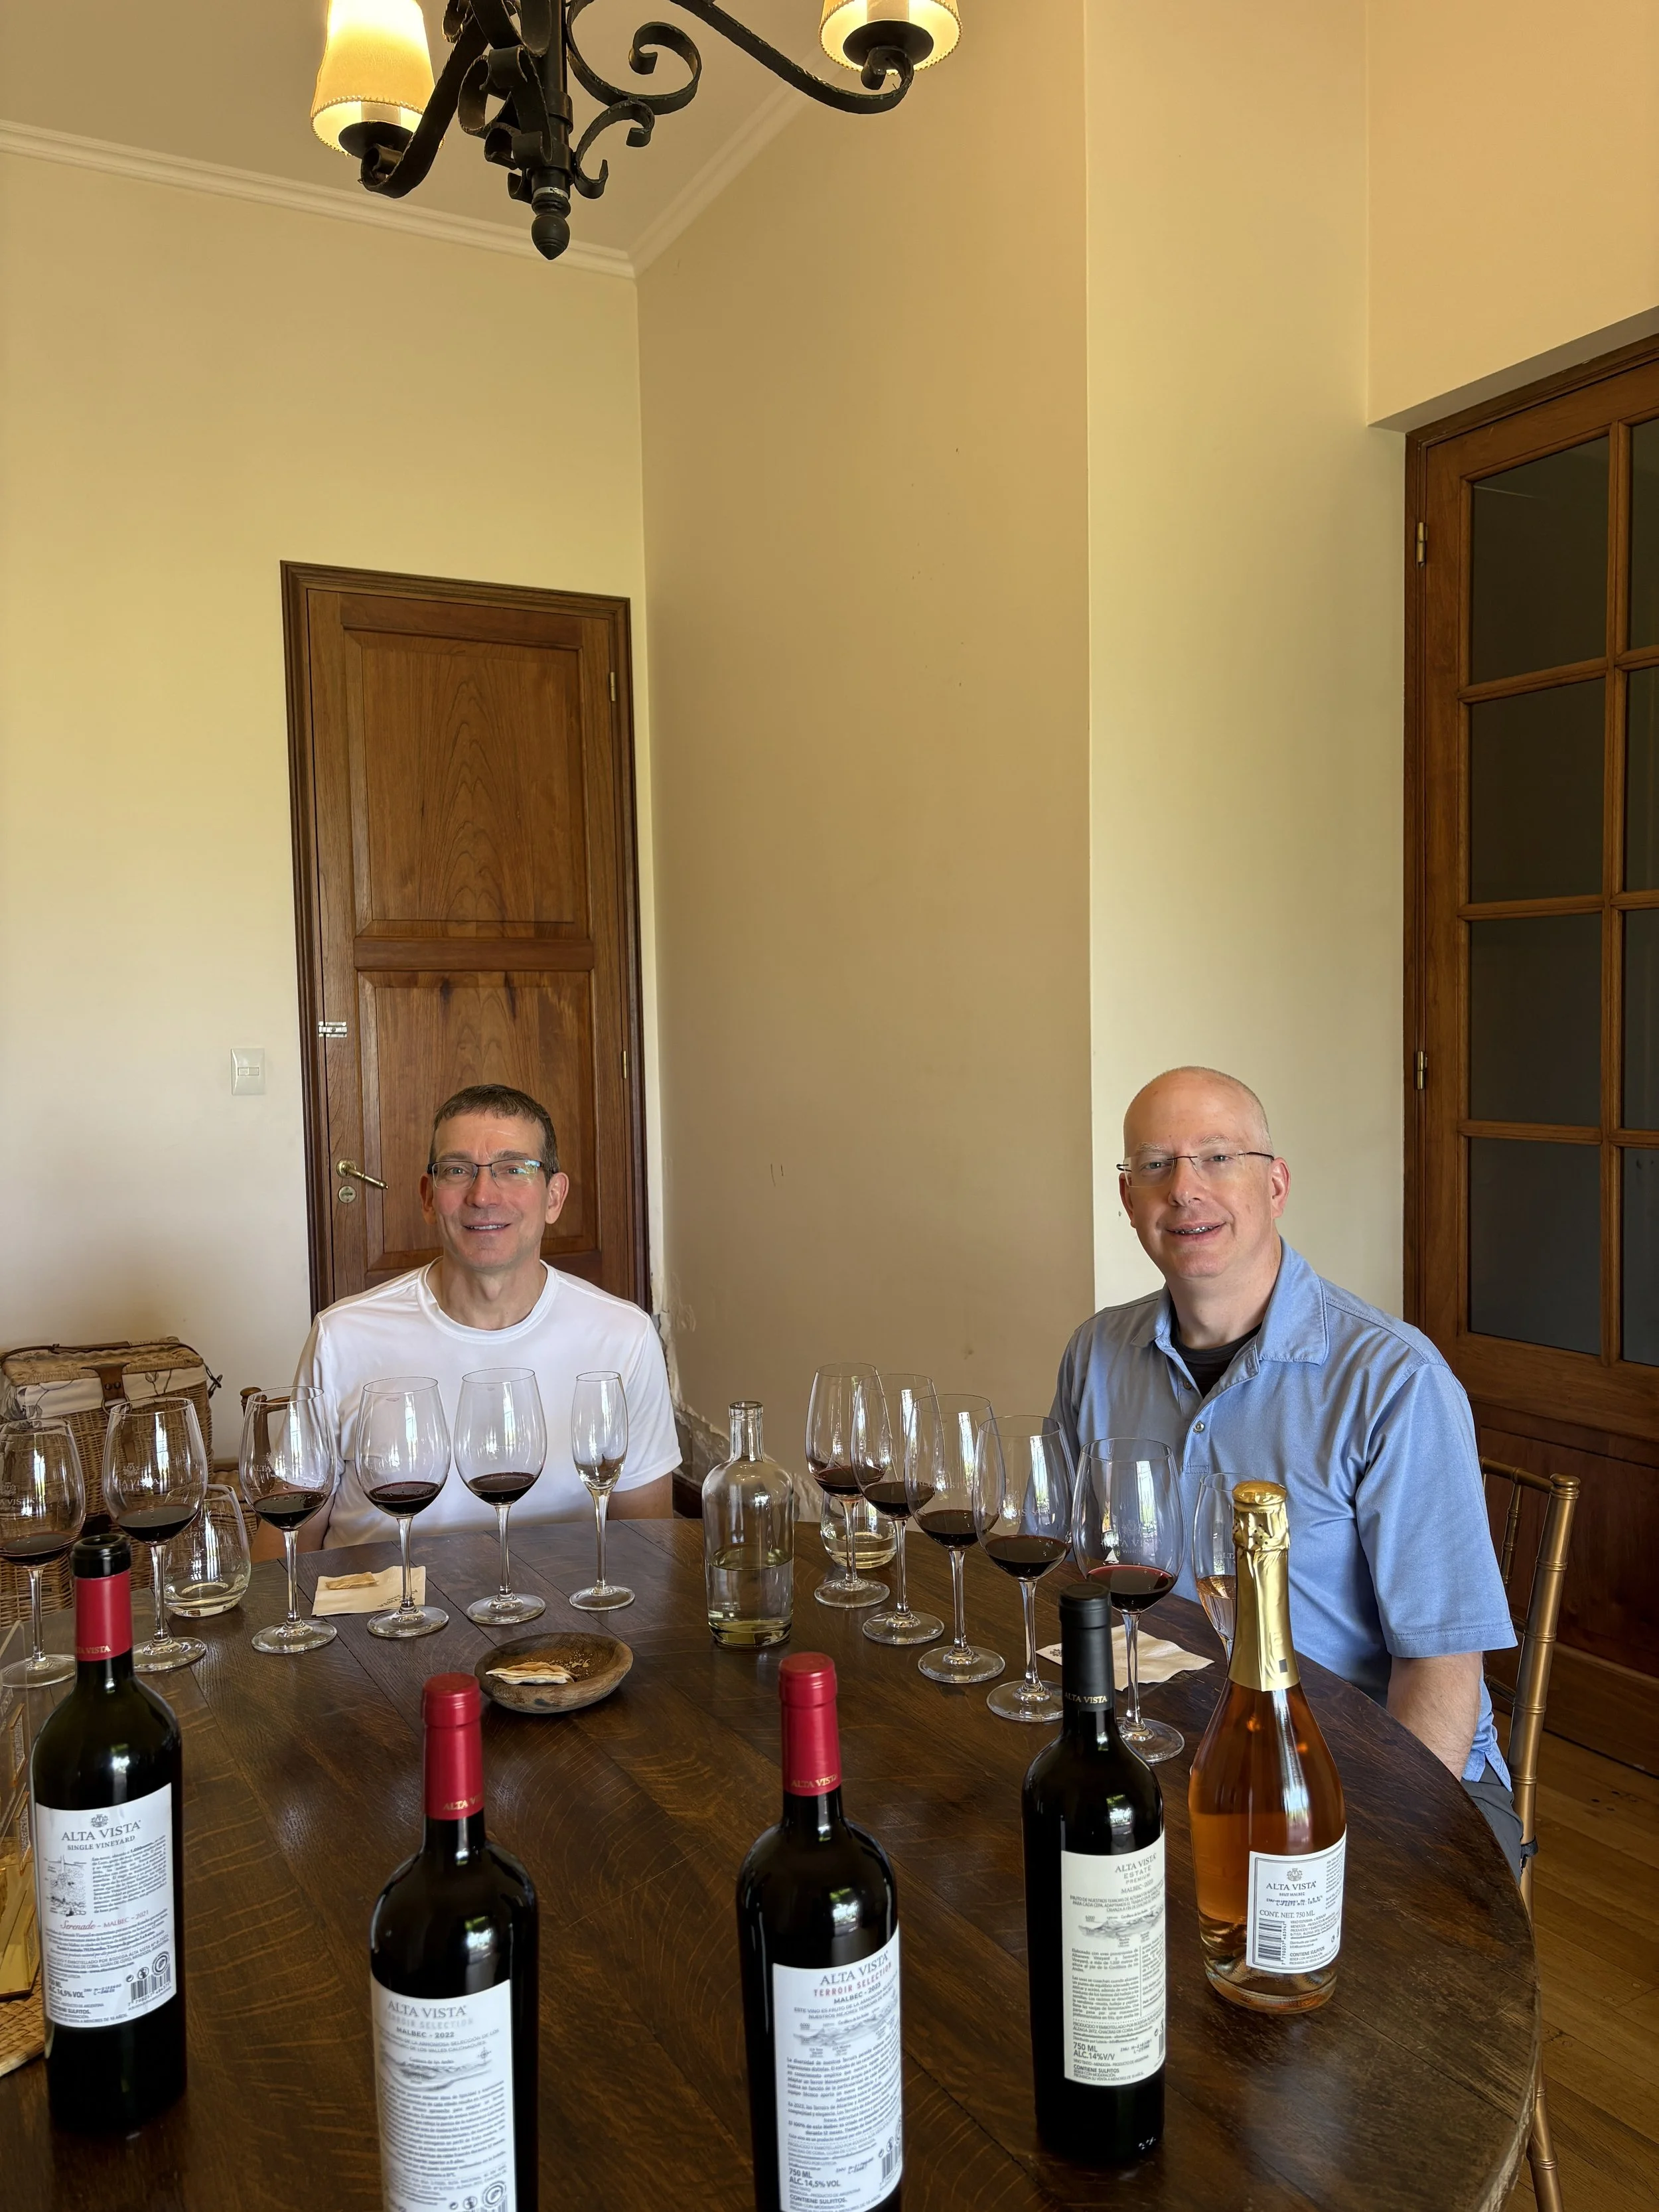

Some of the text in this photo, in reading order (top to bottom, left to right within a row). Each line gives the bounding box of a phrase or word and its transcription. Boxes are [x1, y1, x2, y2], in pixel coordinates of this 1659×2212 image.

[86, 1645, 111, 1654] VISTA
[1064, 1692, 1108, 1704] ALTA VISTA
[791, 1779, 815, 1789] ALTA
[443, 1799, 469, 1811] ALTA
[61, 1821, 141, 1841] ALTA VISTA
[95, 1835, 135, 1849] VINEYARD
[1115, 1854, 1156, 1874] ALTA VISTA
[1124, 1865, 1152, 1880] ESTATE
[1125, 1873, 1151, 1884] PREMIUM
[1121, 1883, 1142, 1894] MALBEC
[60, 1910, 149, 1930] Serenade MALBEC 2021
[1260, 1909, 1279, 1919] CONT.
[820, 1953, 889, 1986] ALTA VISTA
[814, 1962, 892, 1997] TERROIR SELECTION
[57, 1988, 73, 1997] 14,5%
[833, 1981, 881, 2004] MALBEC 2023
[388, 2000, 466, 2019] ALTA VISTA
[836, 2009, 858, 2018] MEJORES
[396, 2026, 427, 2037] MALBEC
[1073, 2041, 1098, 2053] 750 ML
[1074, 2064, 1097, 2073] CONTIENE
[789, 2167, 813, 2179] 750 ML
[789, 2175, 804, 2185] ALC.
[804, 2179, 826, 2188] 14,5%
[790, 2193, 818, 2203] CONTIENE
